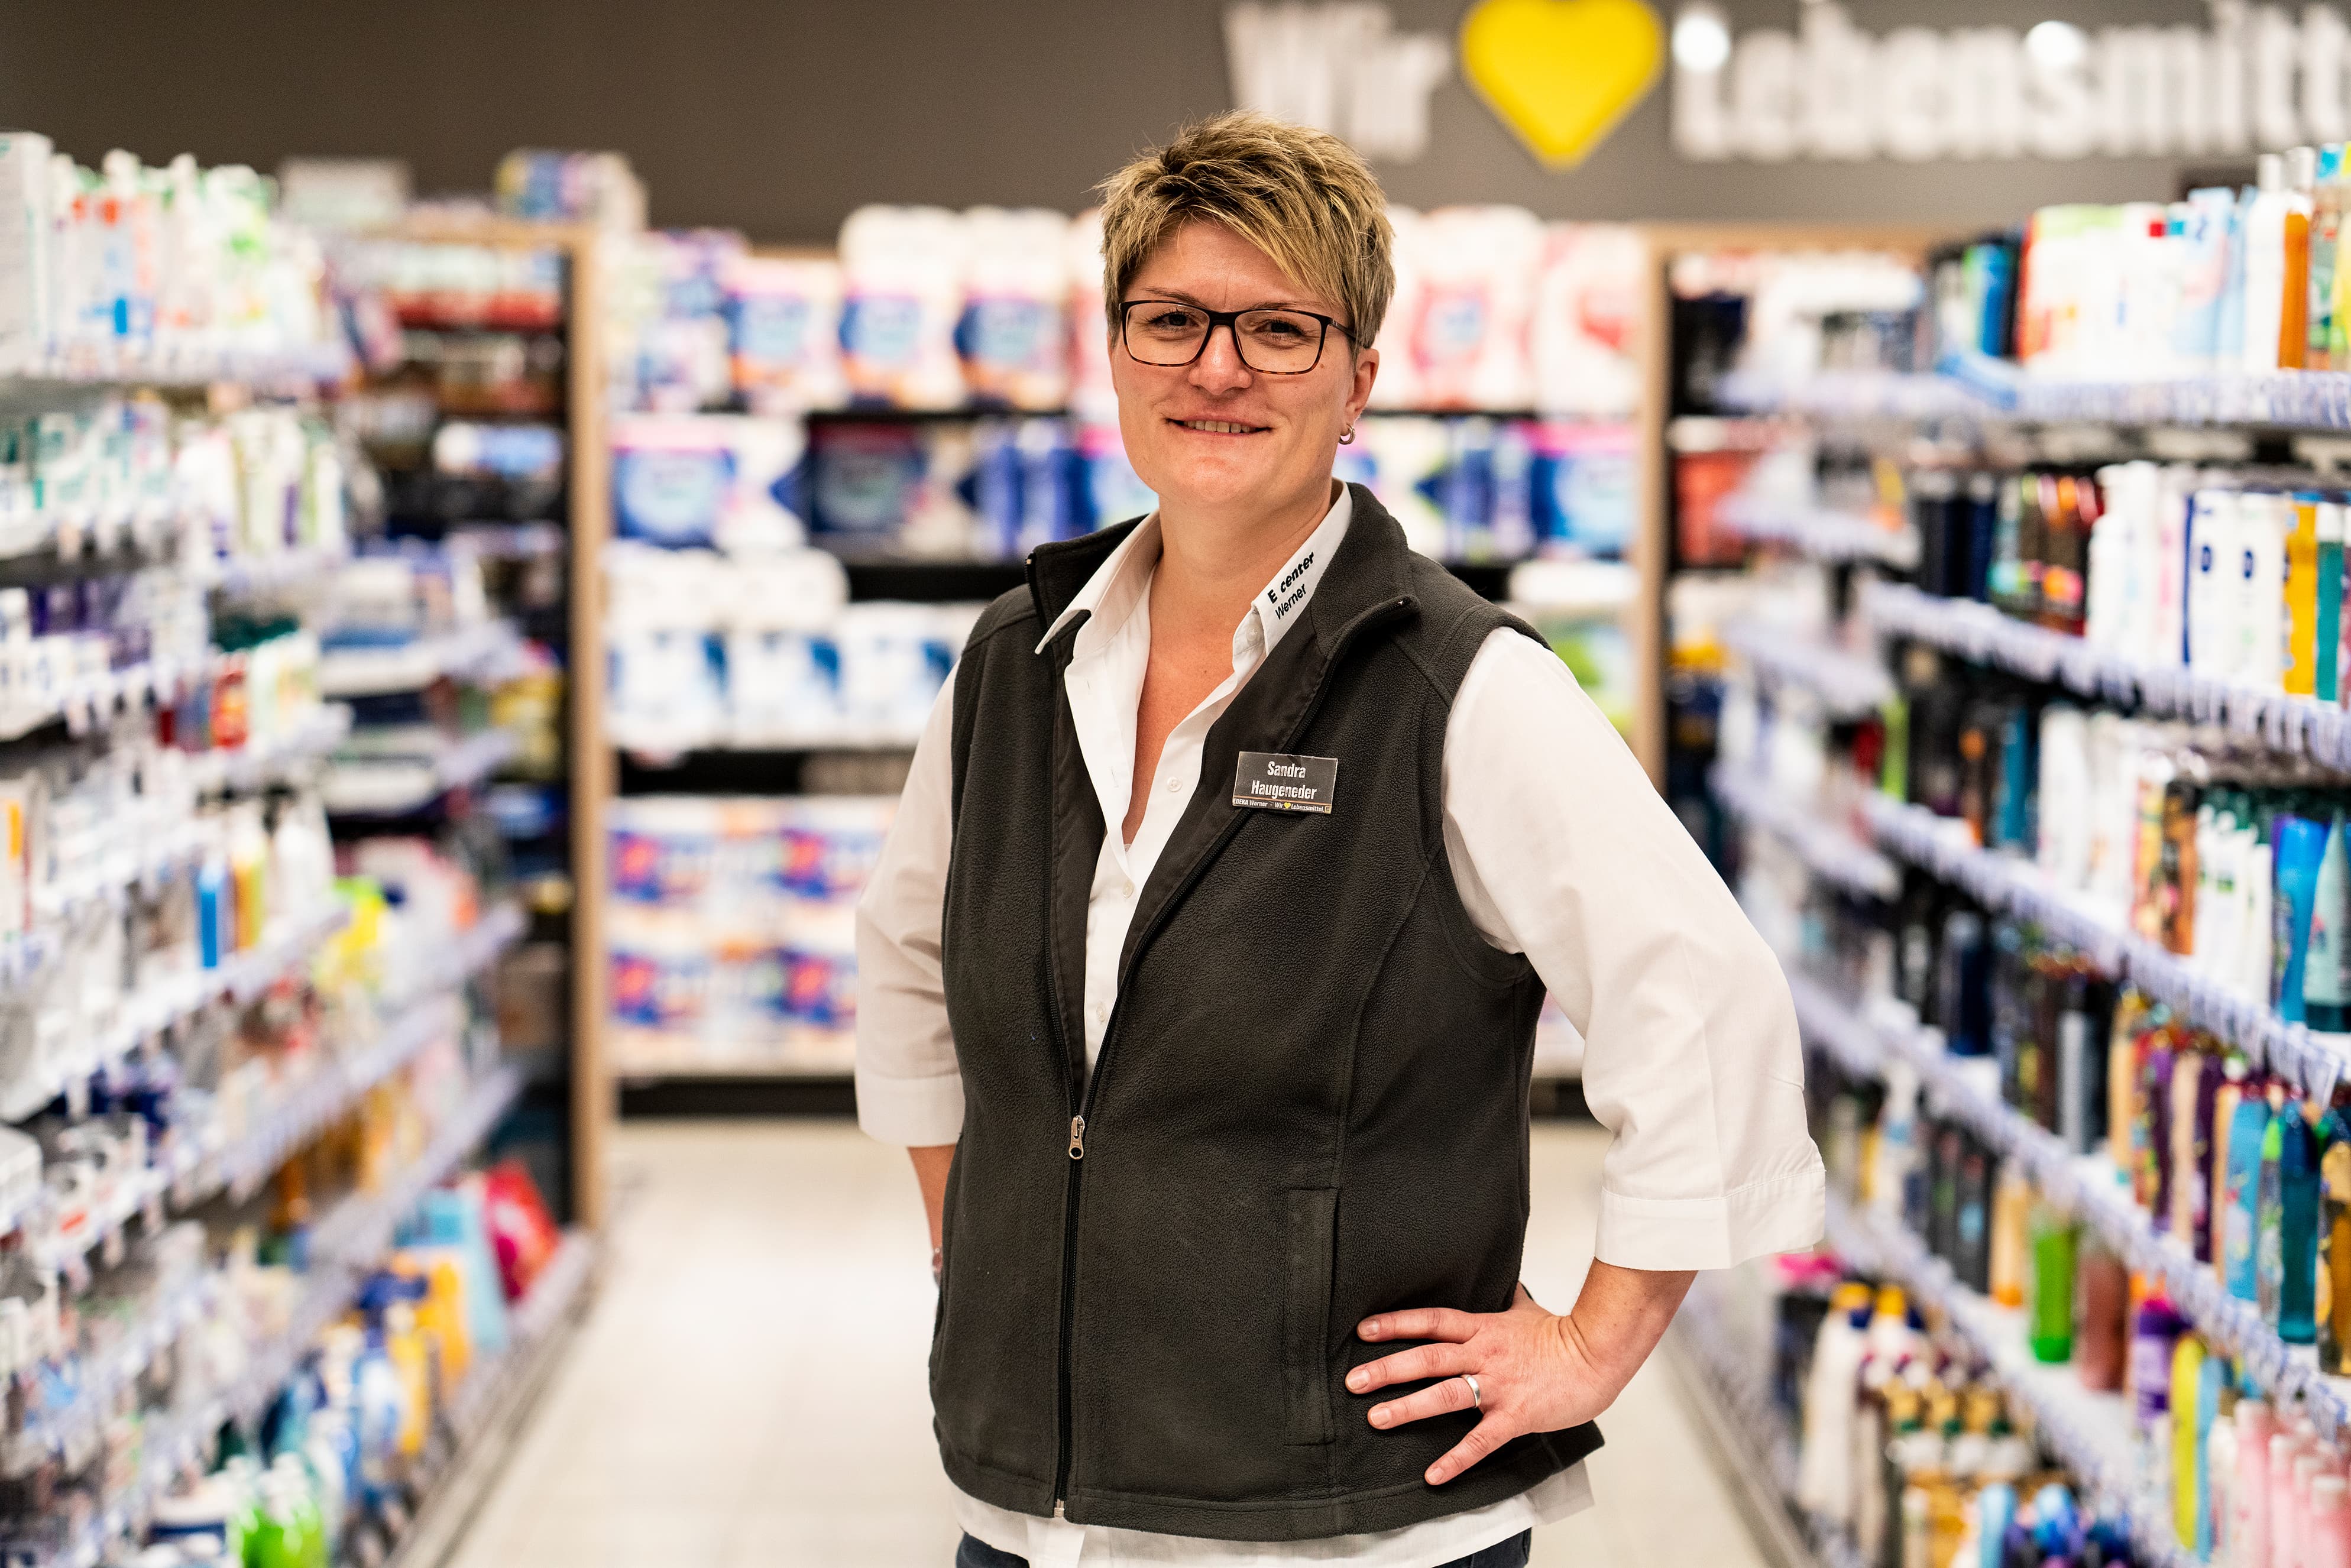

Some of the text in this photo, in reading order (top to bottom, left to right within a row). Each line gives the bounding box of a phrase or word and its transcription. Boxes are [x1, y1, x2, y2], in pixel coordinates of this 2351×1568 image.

[1224, 2, 1452, 160] Wir
[1267, 552, 1314, 604] E center
[1275, 584, 1307, 620] Werner
[1267, 761, 1306, 778] Sandra
[1251, 779, 1317, 799] Haugeneder
[1291, 804, 1325, 812] Lebensmittel.
